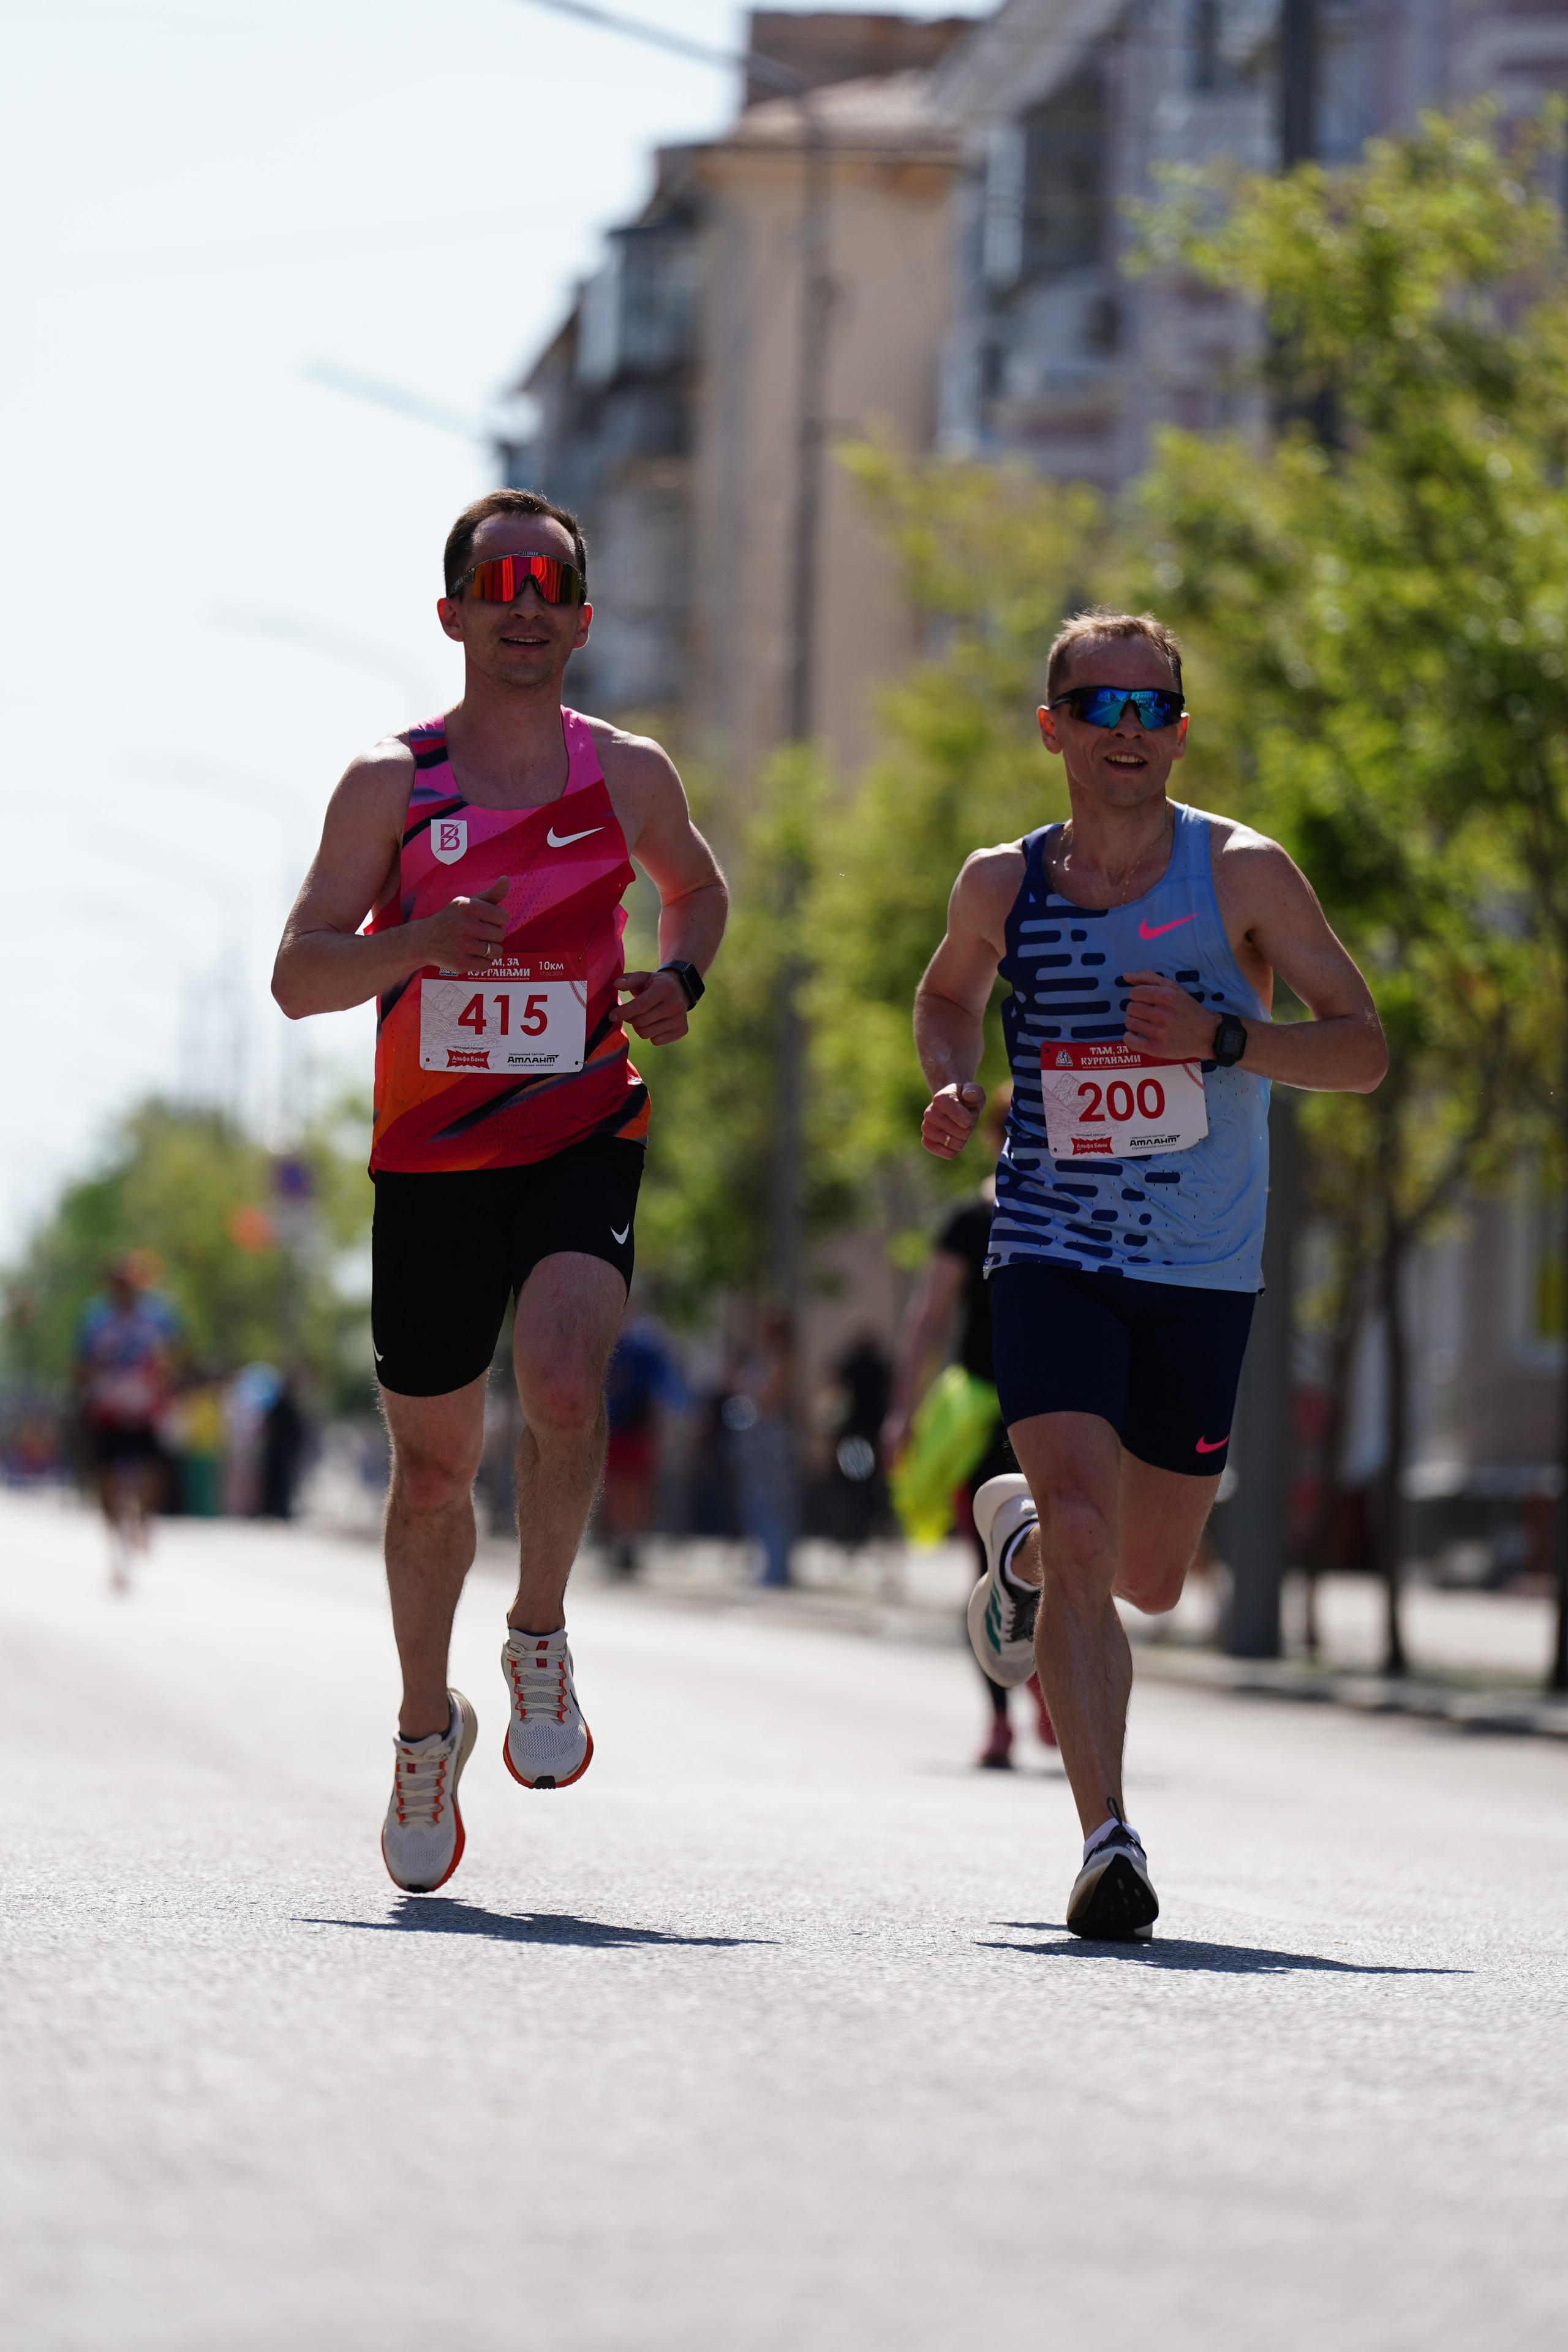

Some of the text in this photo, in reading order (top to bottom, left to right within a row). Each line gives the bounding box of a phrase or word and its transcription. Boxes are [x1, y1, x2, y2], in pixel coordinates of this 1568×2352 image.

[491, 957, 519, 967] М, ЗА
[467, 968, 530, 977] КУРГАНАМИ
[458, 993, 548, 1036] 415
[1090, 1046, 1129, 1056] ТАМ, ЗА
[1080, 1055, 1141, 1066] КУРГАНАМИ
[1077, 1078, 1166, 1122] 200
